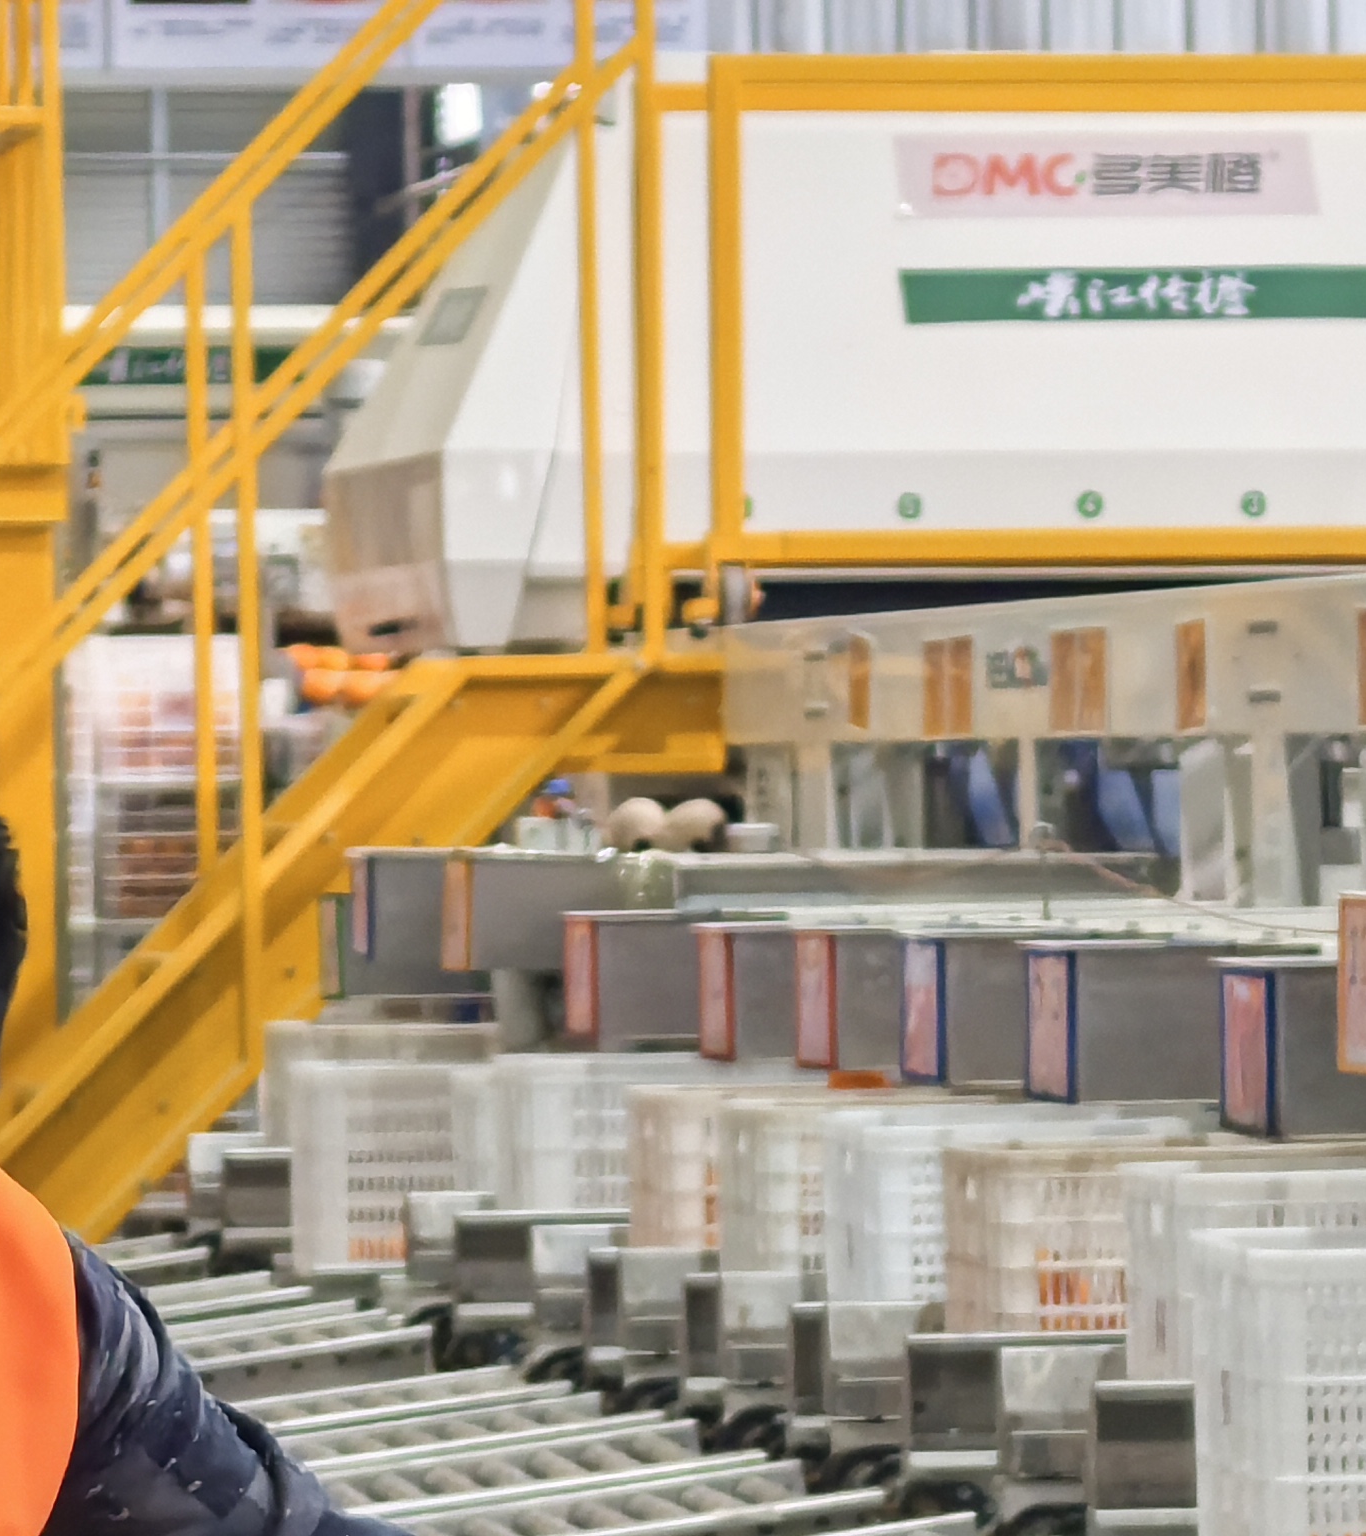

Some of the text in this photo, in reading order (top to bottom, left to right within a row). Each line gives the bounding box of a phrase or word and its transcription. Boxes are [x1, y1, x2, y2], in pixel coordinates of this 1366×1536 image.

[932, 152, 1077, 198] DMC
[1092, 152, 1262, 196] 多美橙
